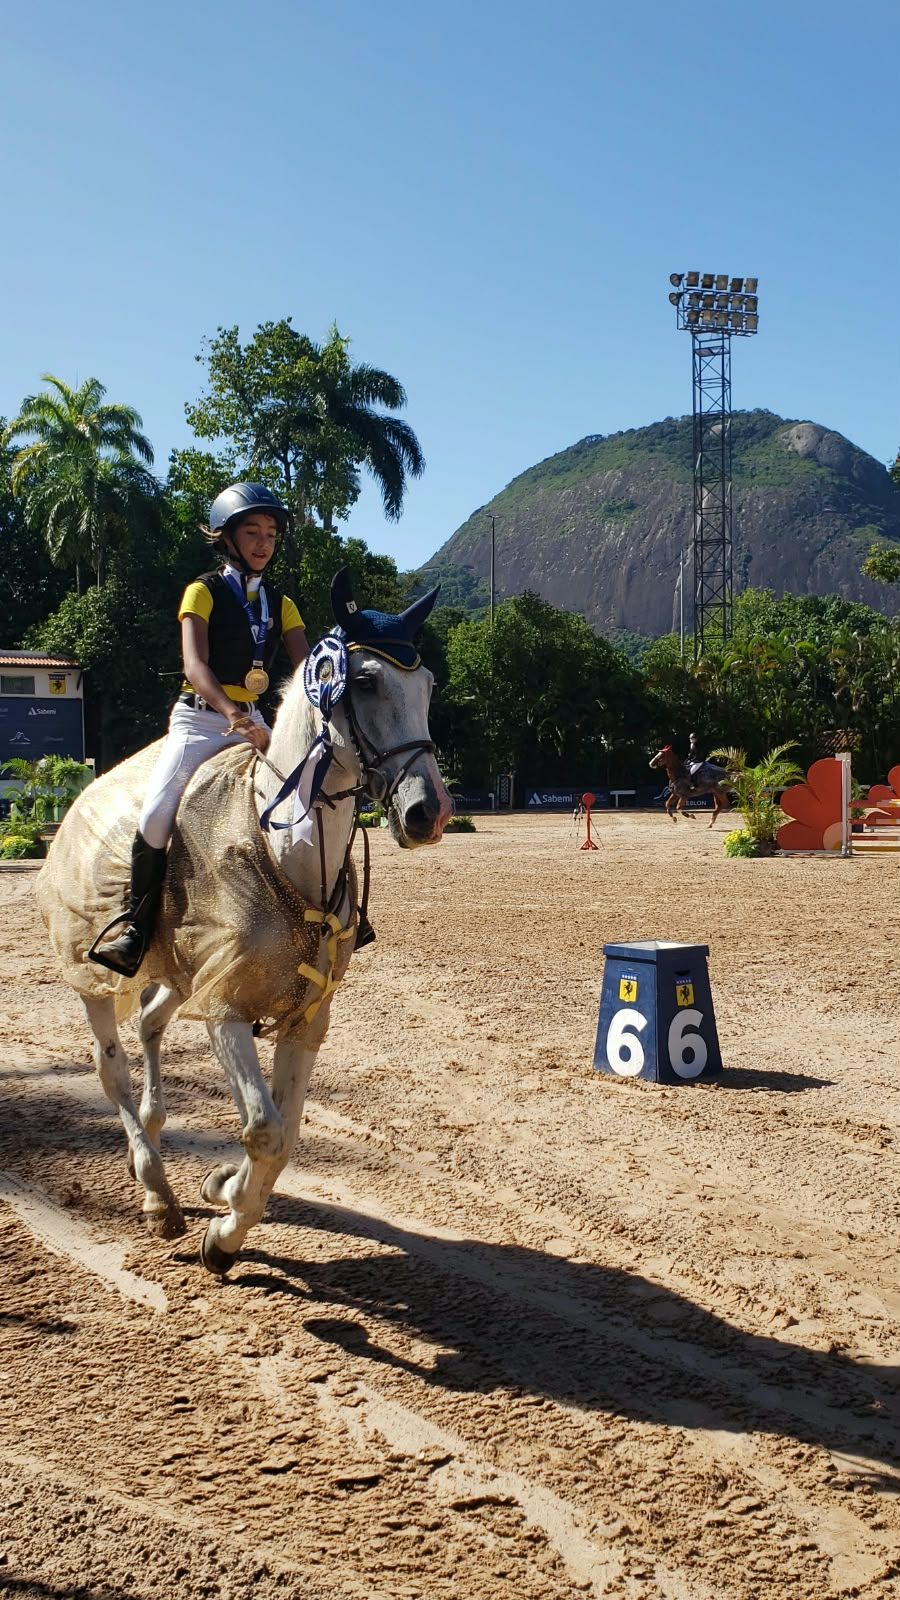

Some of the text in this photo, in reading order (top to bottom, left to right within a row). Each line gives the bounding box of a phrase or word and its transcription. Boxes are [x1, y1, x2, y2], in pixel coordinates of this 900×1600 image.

[542, 794, 573, 803] Sabemi
[606, 1008, 648, 1077] 6
[667, 1008, 708, 1079] 6
